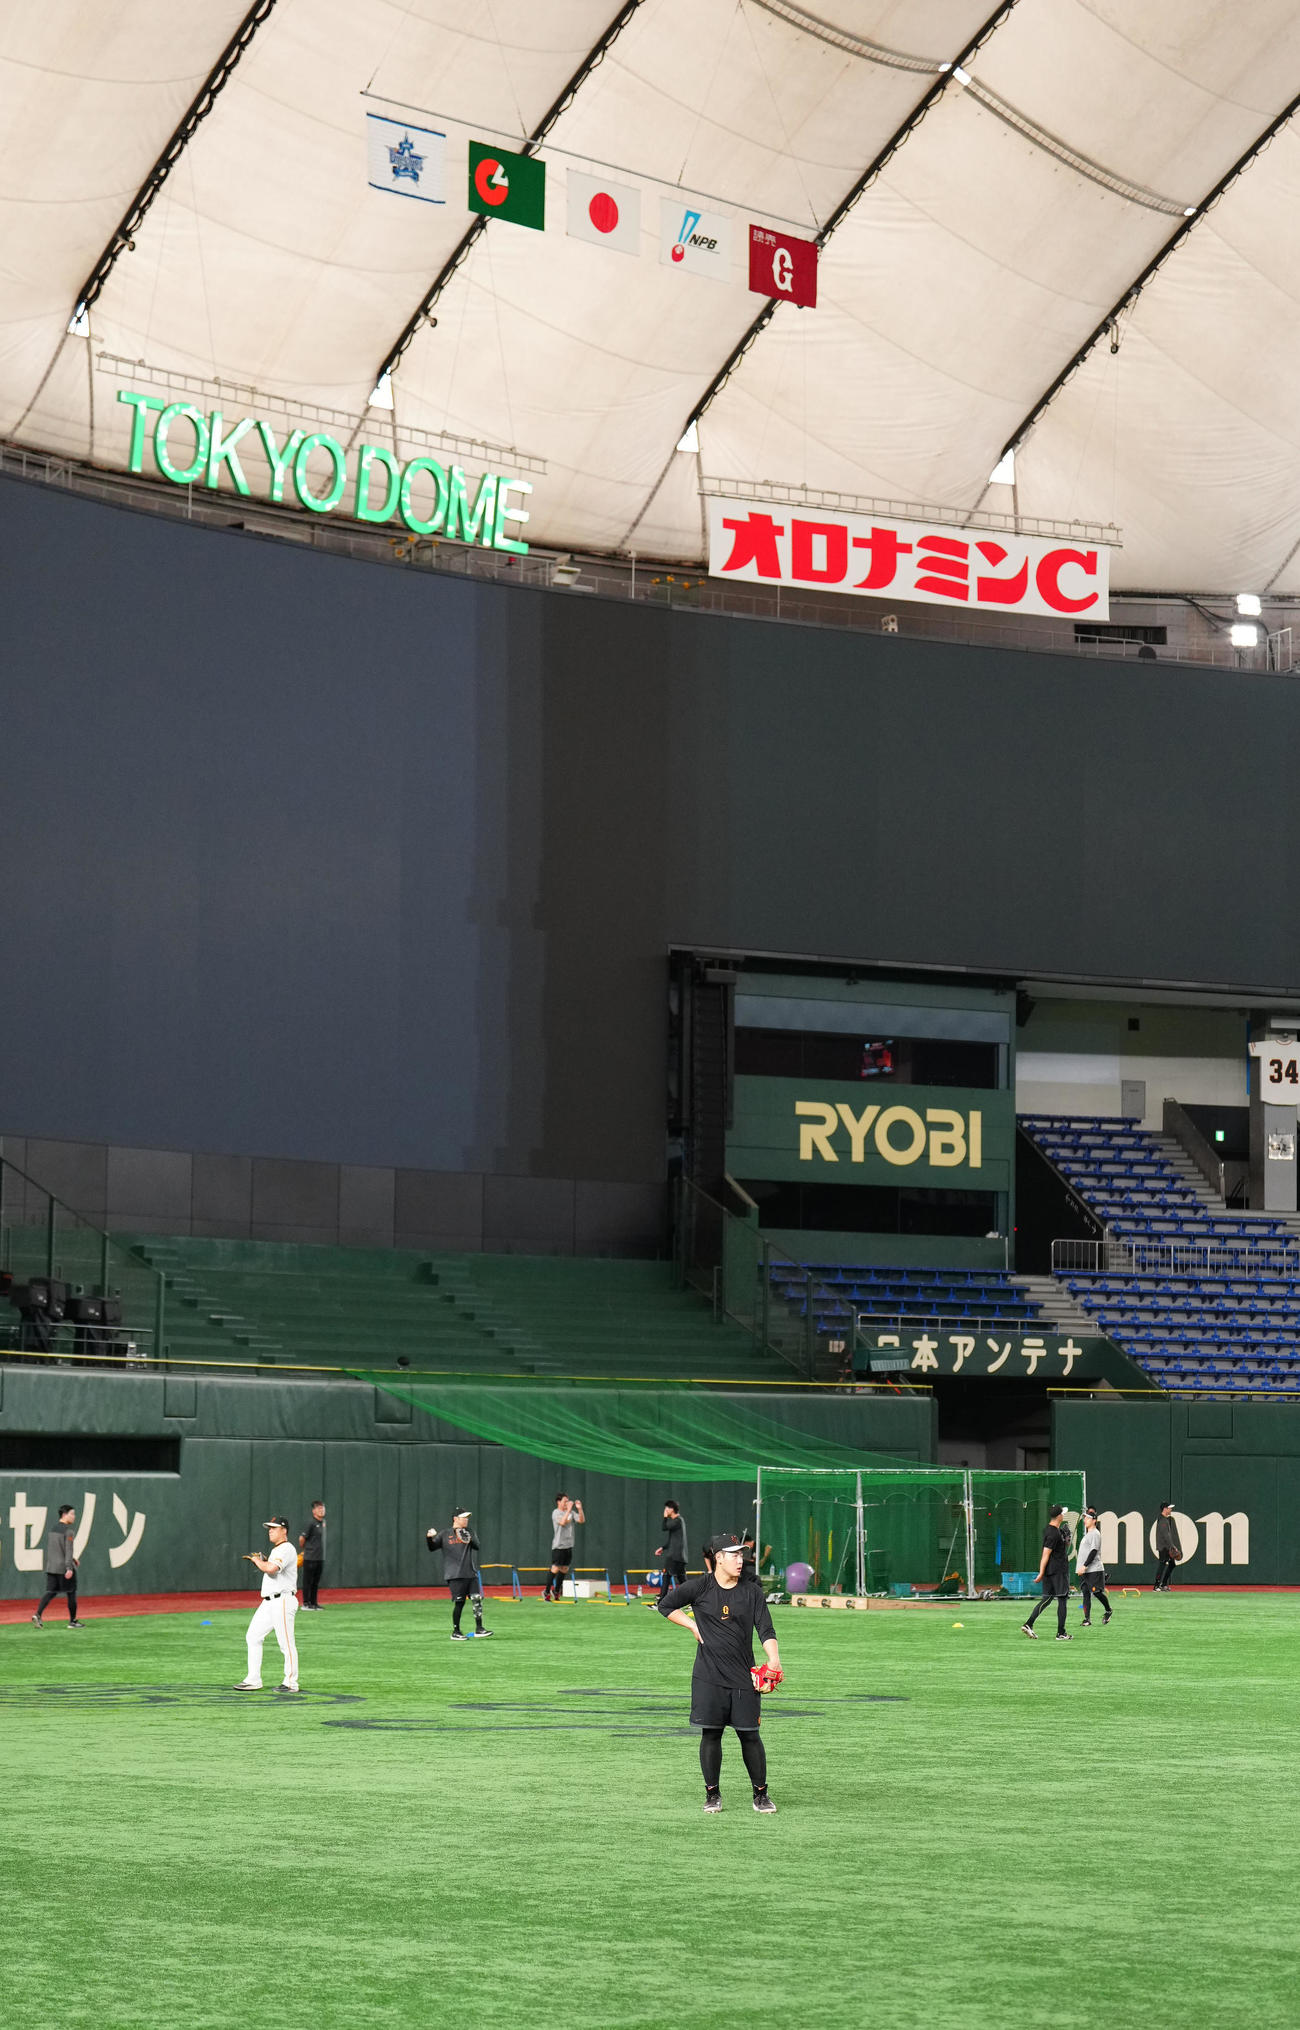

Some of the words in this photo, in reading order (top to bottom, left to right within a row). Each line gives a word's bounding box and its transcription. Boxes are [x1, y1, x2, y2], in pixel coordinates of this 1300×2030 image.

[689, 234, 718, 250] NPB
[772, 247, 794, 292] G
[117, 390, 347, 513] TOKYO
[354, 444, 533, 555] DOME
[721, 511, 1099, 613] オロナミンC
[1269, 1059, 1299, 1084] 34
[795, 1100, 982, 1168] RYOBI
[0, 1491, 146, 1571] セノン
